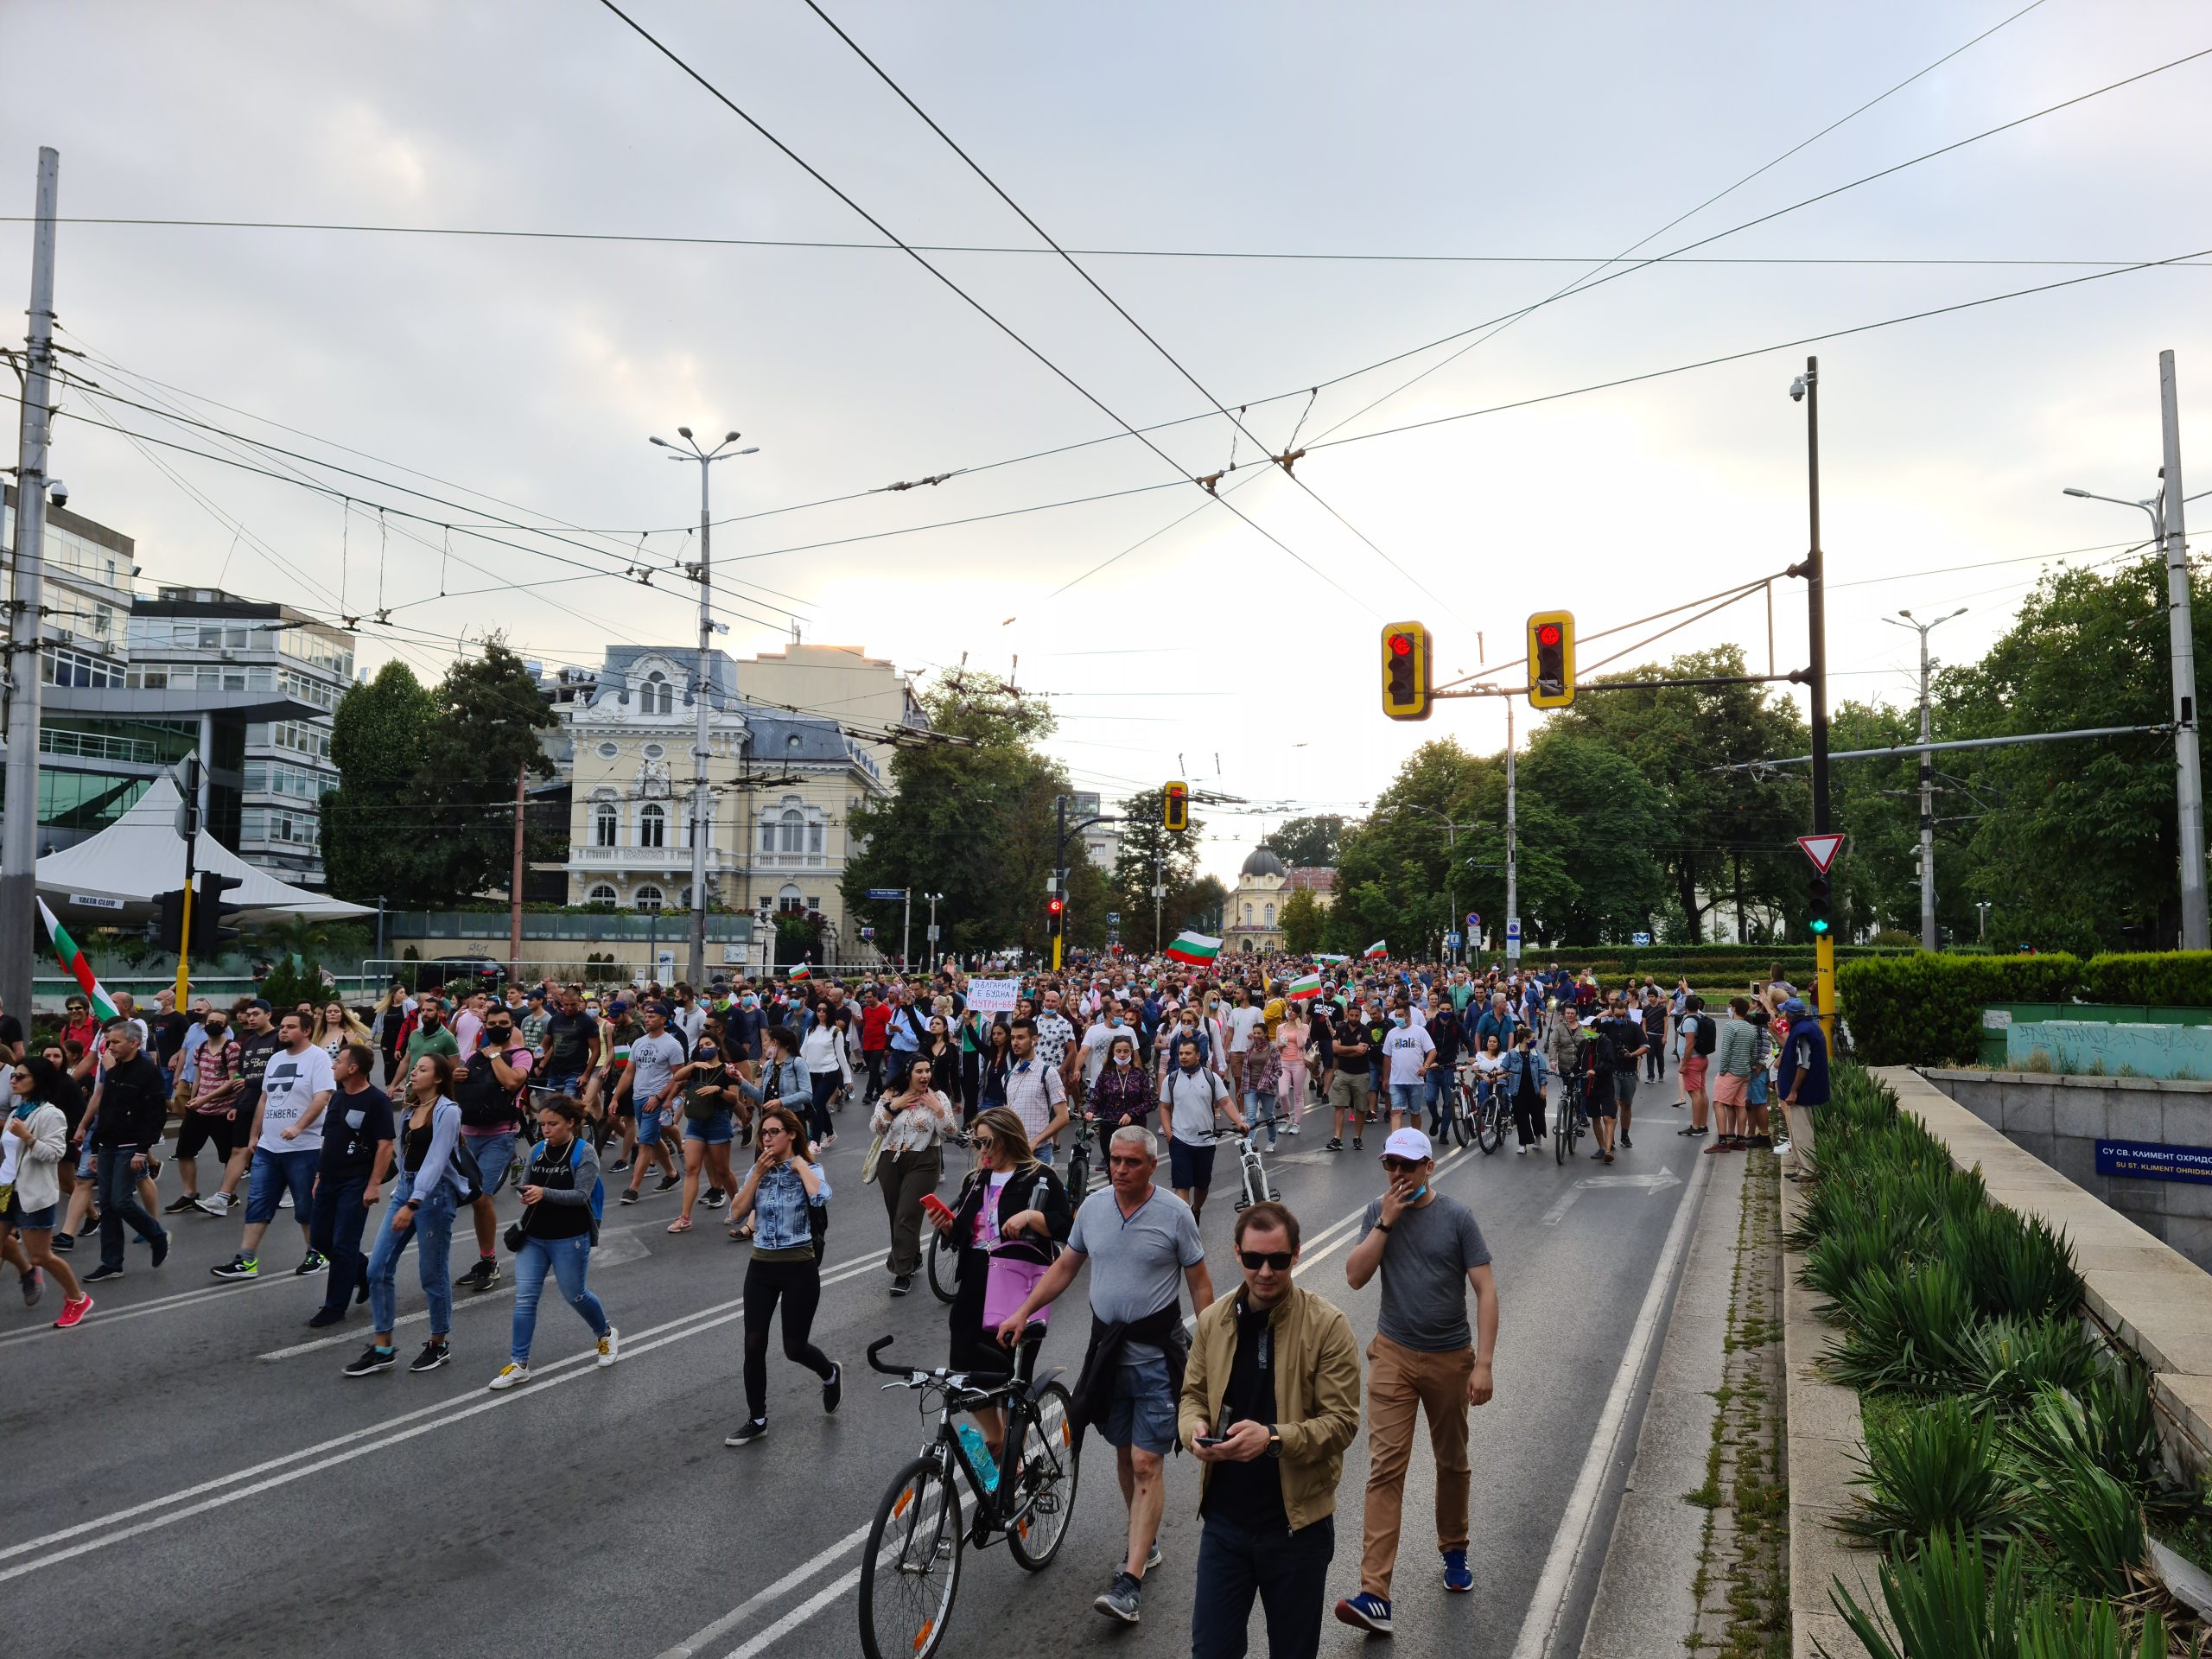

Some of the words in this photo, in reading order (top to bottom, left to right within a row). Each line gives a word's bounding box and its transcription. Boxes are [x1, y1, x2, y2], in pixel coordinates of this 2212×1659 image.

[79, 896, 97, 905] YALTA
[975, 981, 1011, 989] БЪЛГАРИЯ
[985, 989, 1010, 998] БУДНА
[639, 1049, 654, 1058] TOM
[264, 1109, 297, 1119] SENBERG
[2116, 1148, 2131, 1157] СВ.
[2133, 1150, 2175, 1160] КЛИМЕНТ
[2140, 1164, 2175, 1173] KLIMENT
